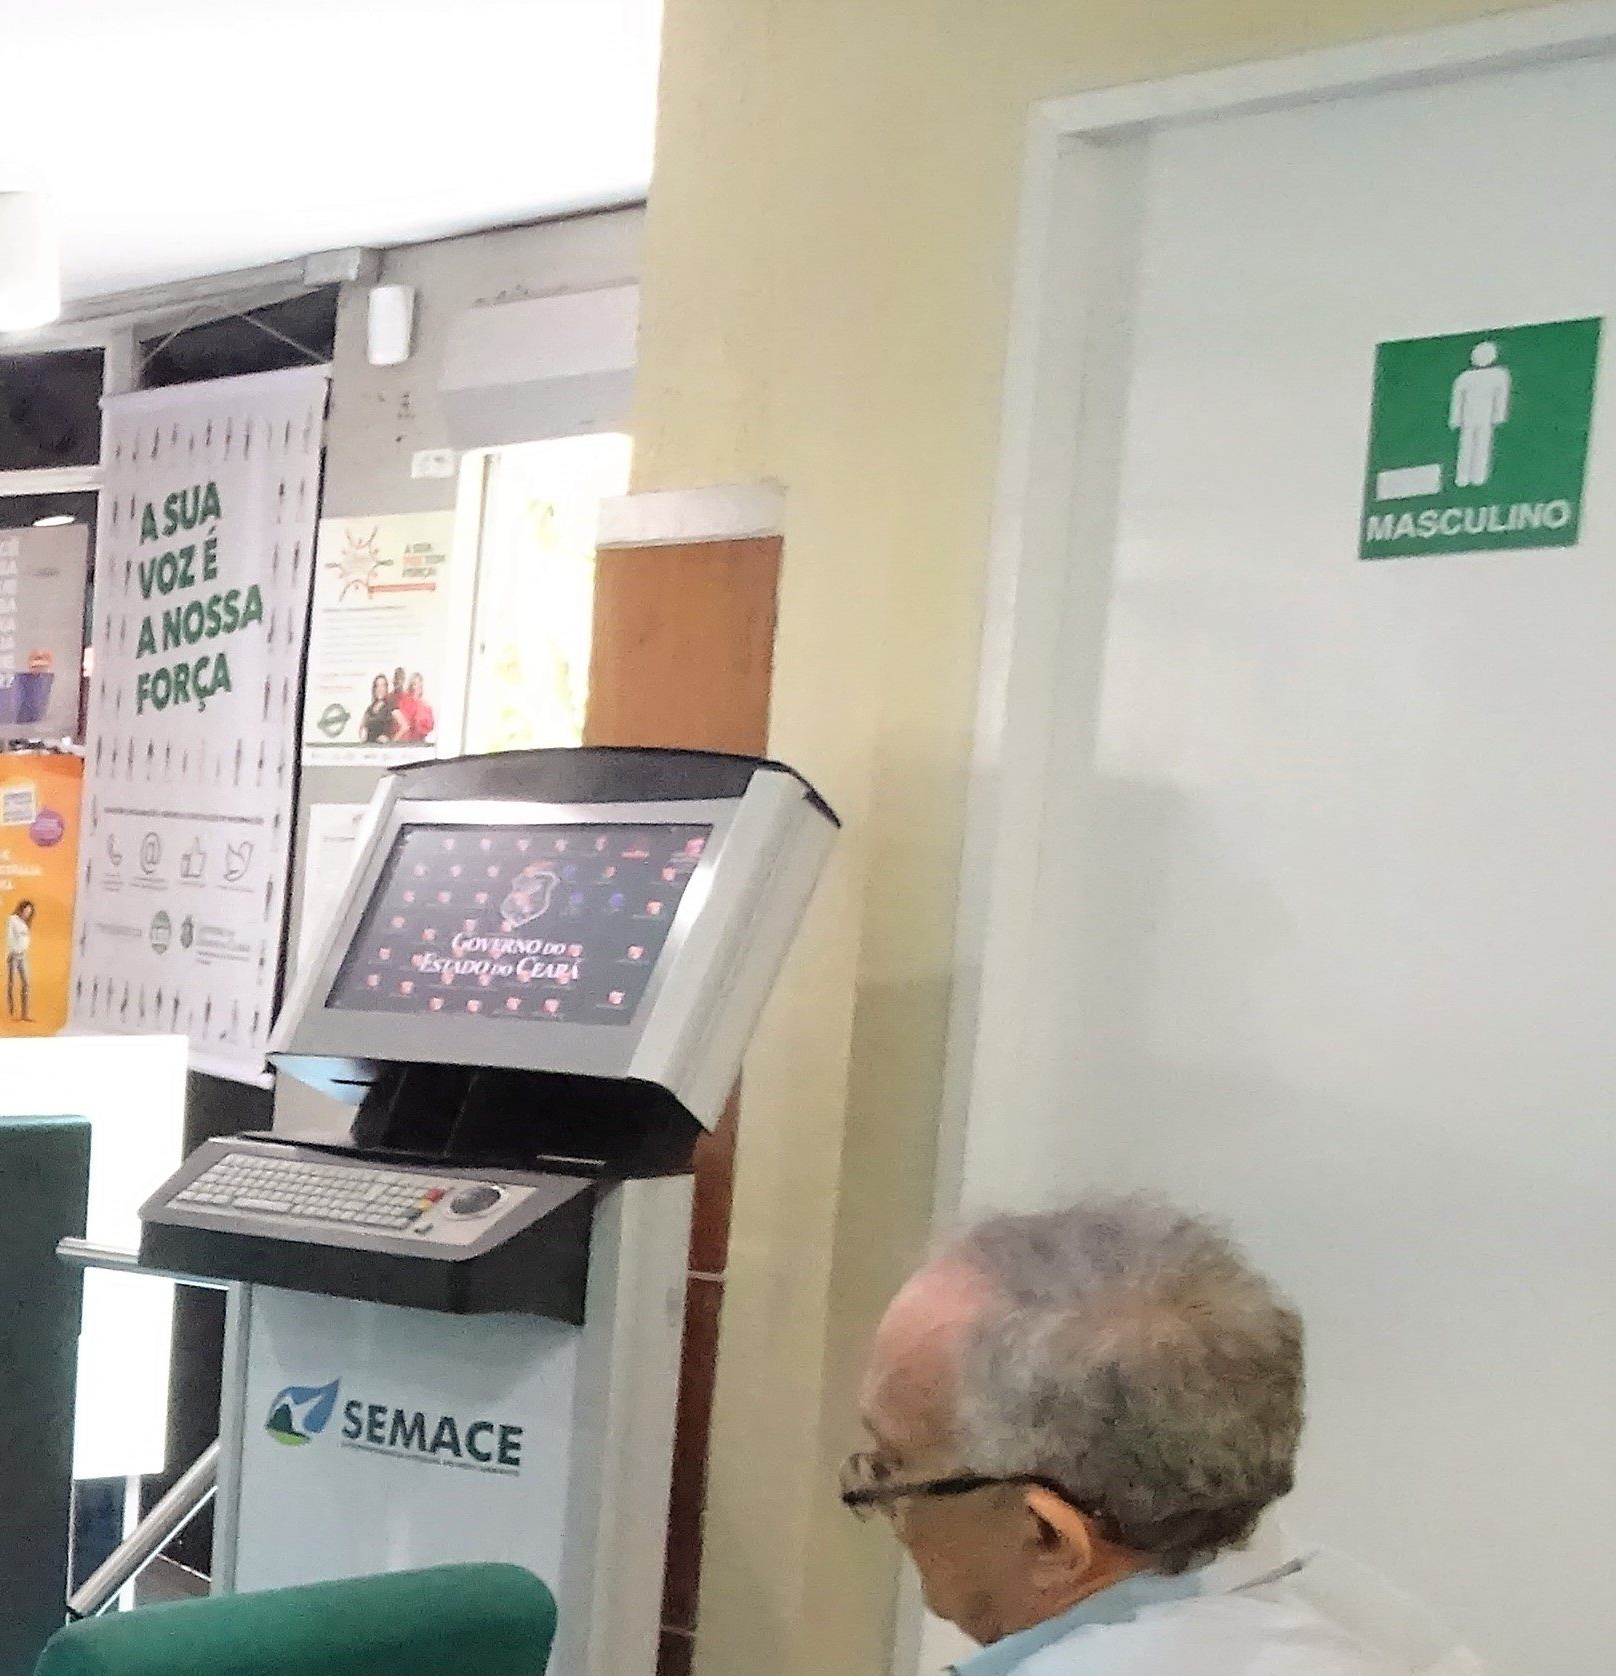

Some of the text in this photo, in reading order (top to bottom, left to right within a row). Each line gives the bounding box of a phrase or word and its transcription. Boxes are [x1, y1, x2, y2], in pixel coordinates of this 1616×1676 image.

[139, 481, 221, 546] A SUA
[1366, 499, 1572, 542] MASCULINO
[138, 525, 217, 599] VOZ É
[136, 584, 263, 659] A NOSSA
[136, 653, 231, 716] FORÇA
[341, 1400, 524, 1466] SEMACE
